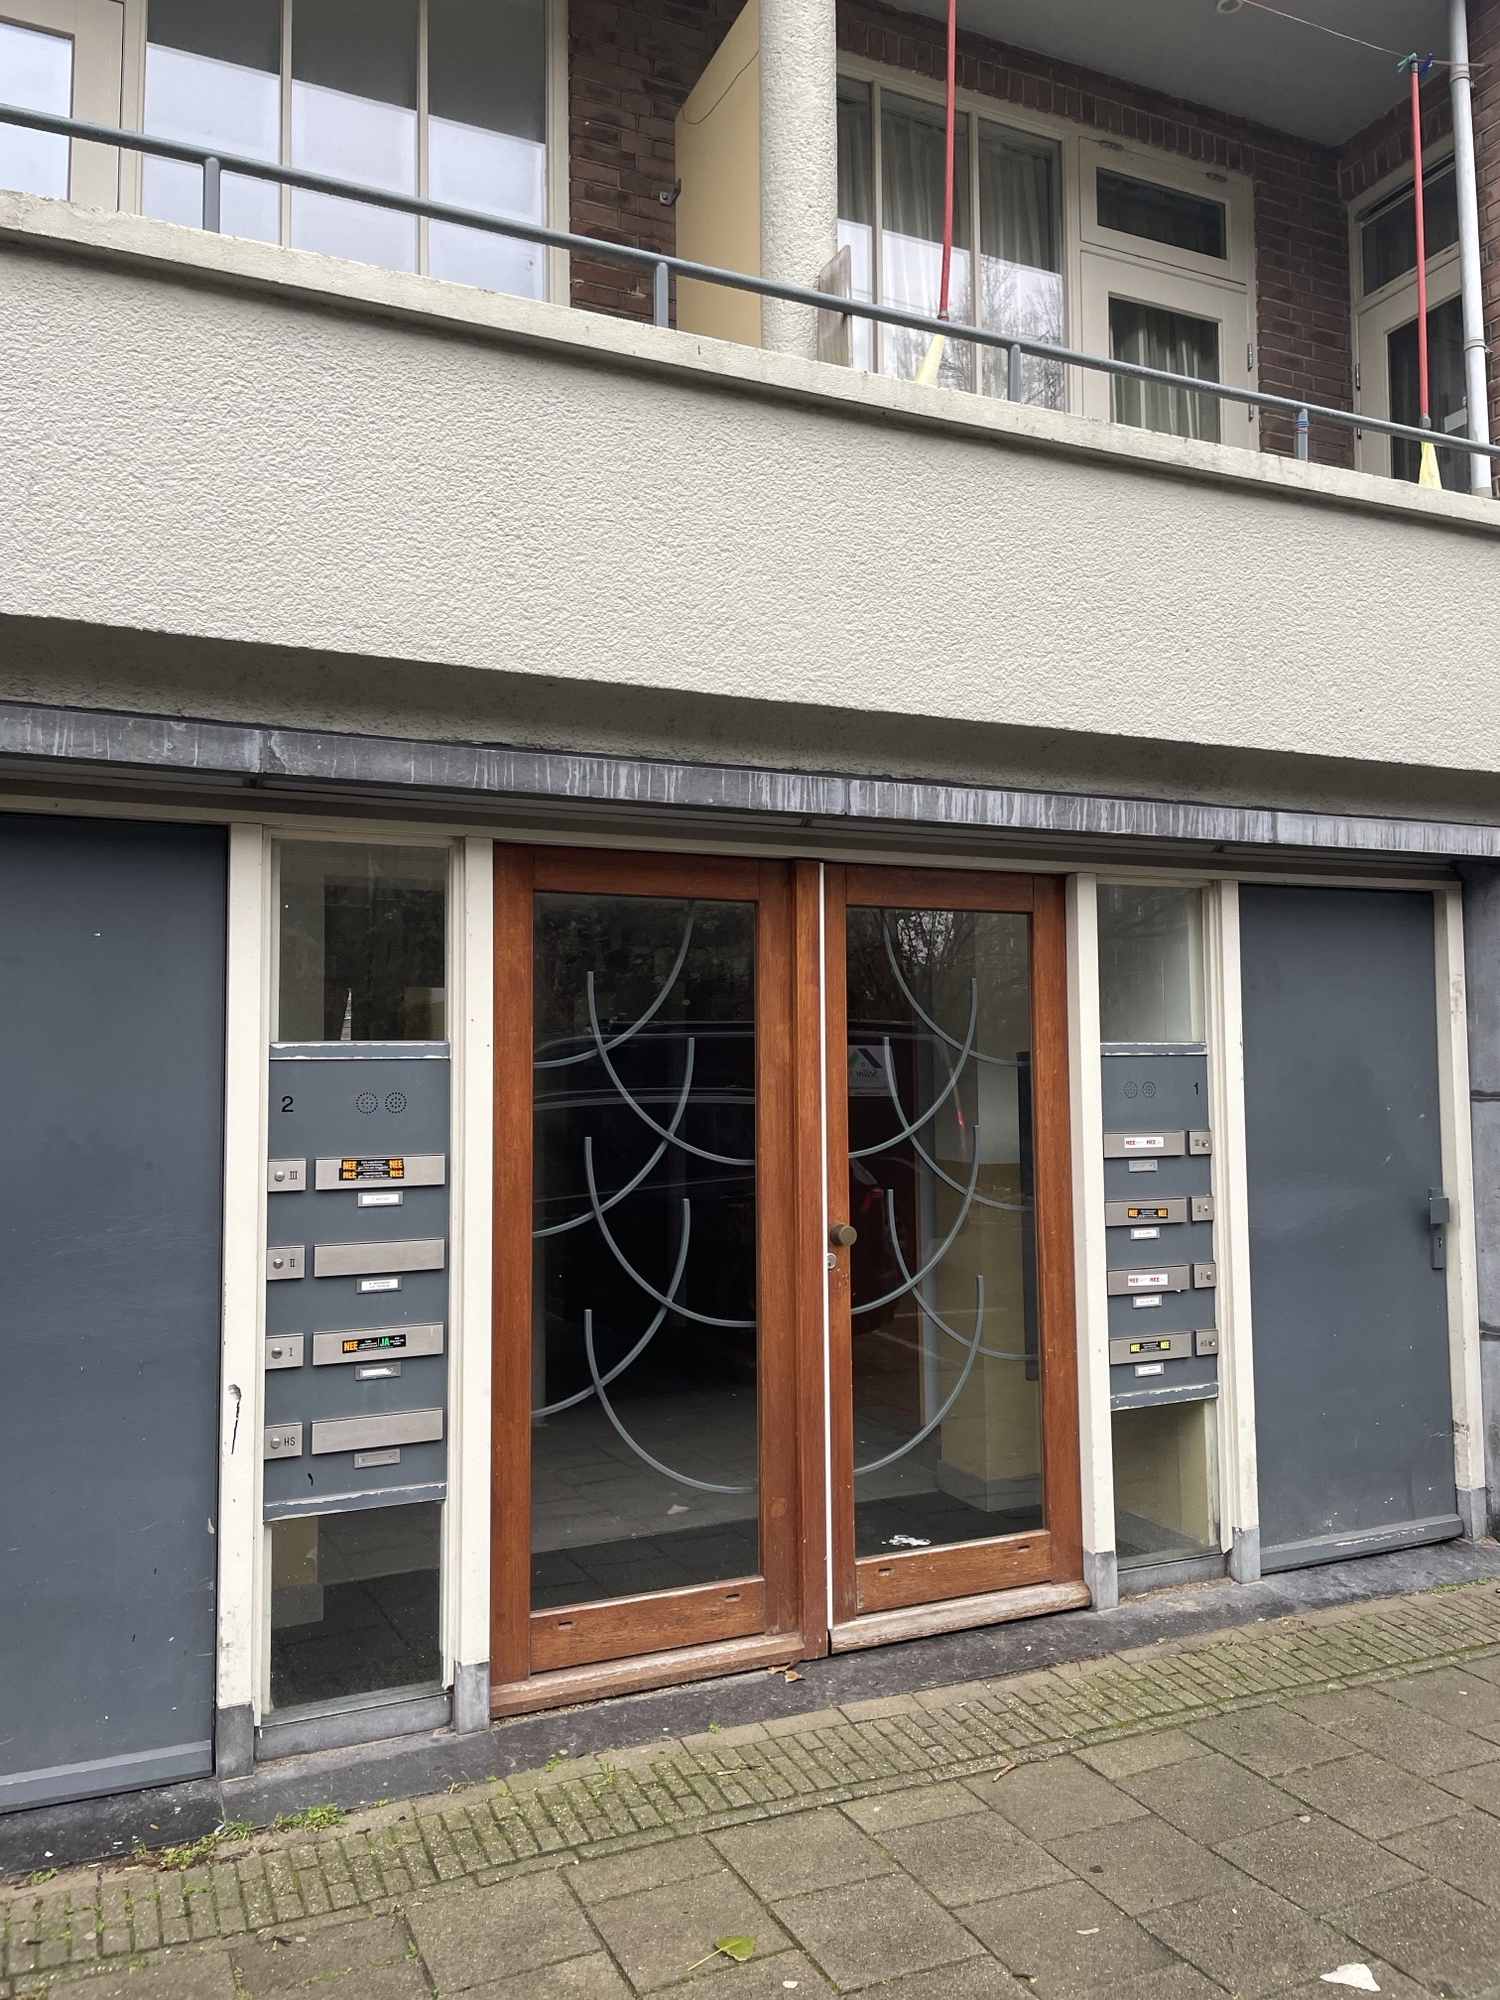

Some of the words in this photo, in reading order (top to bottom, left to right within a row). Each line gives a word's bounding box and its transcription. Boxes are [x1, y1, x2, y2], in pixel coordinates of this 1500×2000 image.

[1193, 1082, 1199, 1095] 1
[281, 1095, 294, 1113] 2
[343, 1160, 358, 1170] NEE
[389, 1159, 403, 1169] NEE
[289, 1171, 297, 1180] III
[343, 1171, 357, 1179] NEE
[289, 1258, 296, 1268] II
[344, 1341, 358, 1350] NEE
[380, 1336, 390, 1347] JA
[284, 1436, 296, 1446] HS
